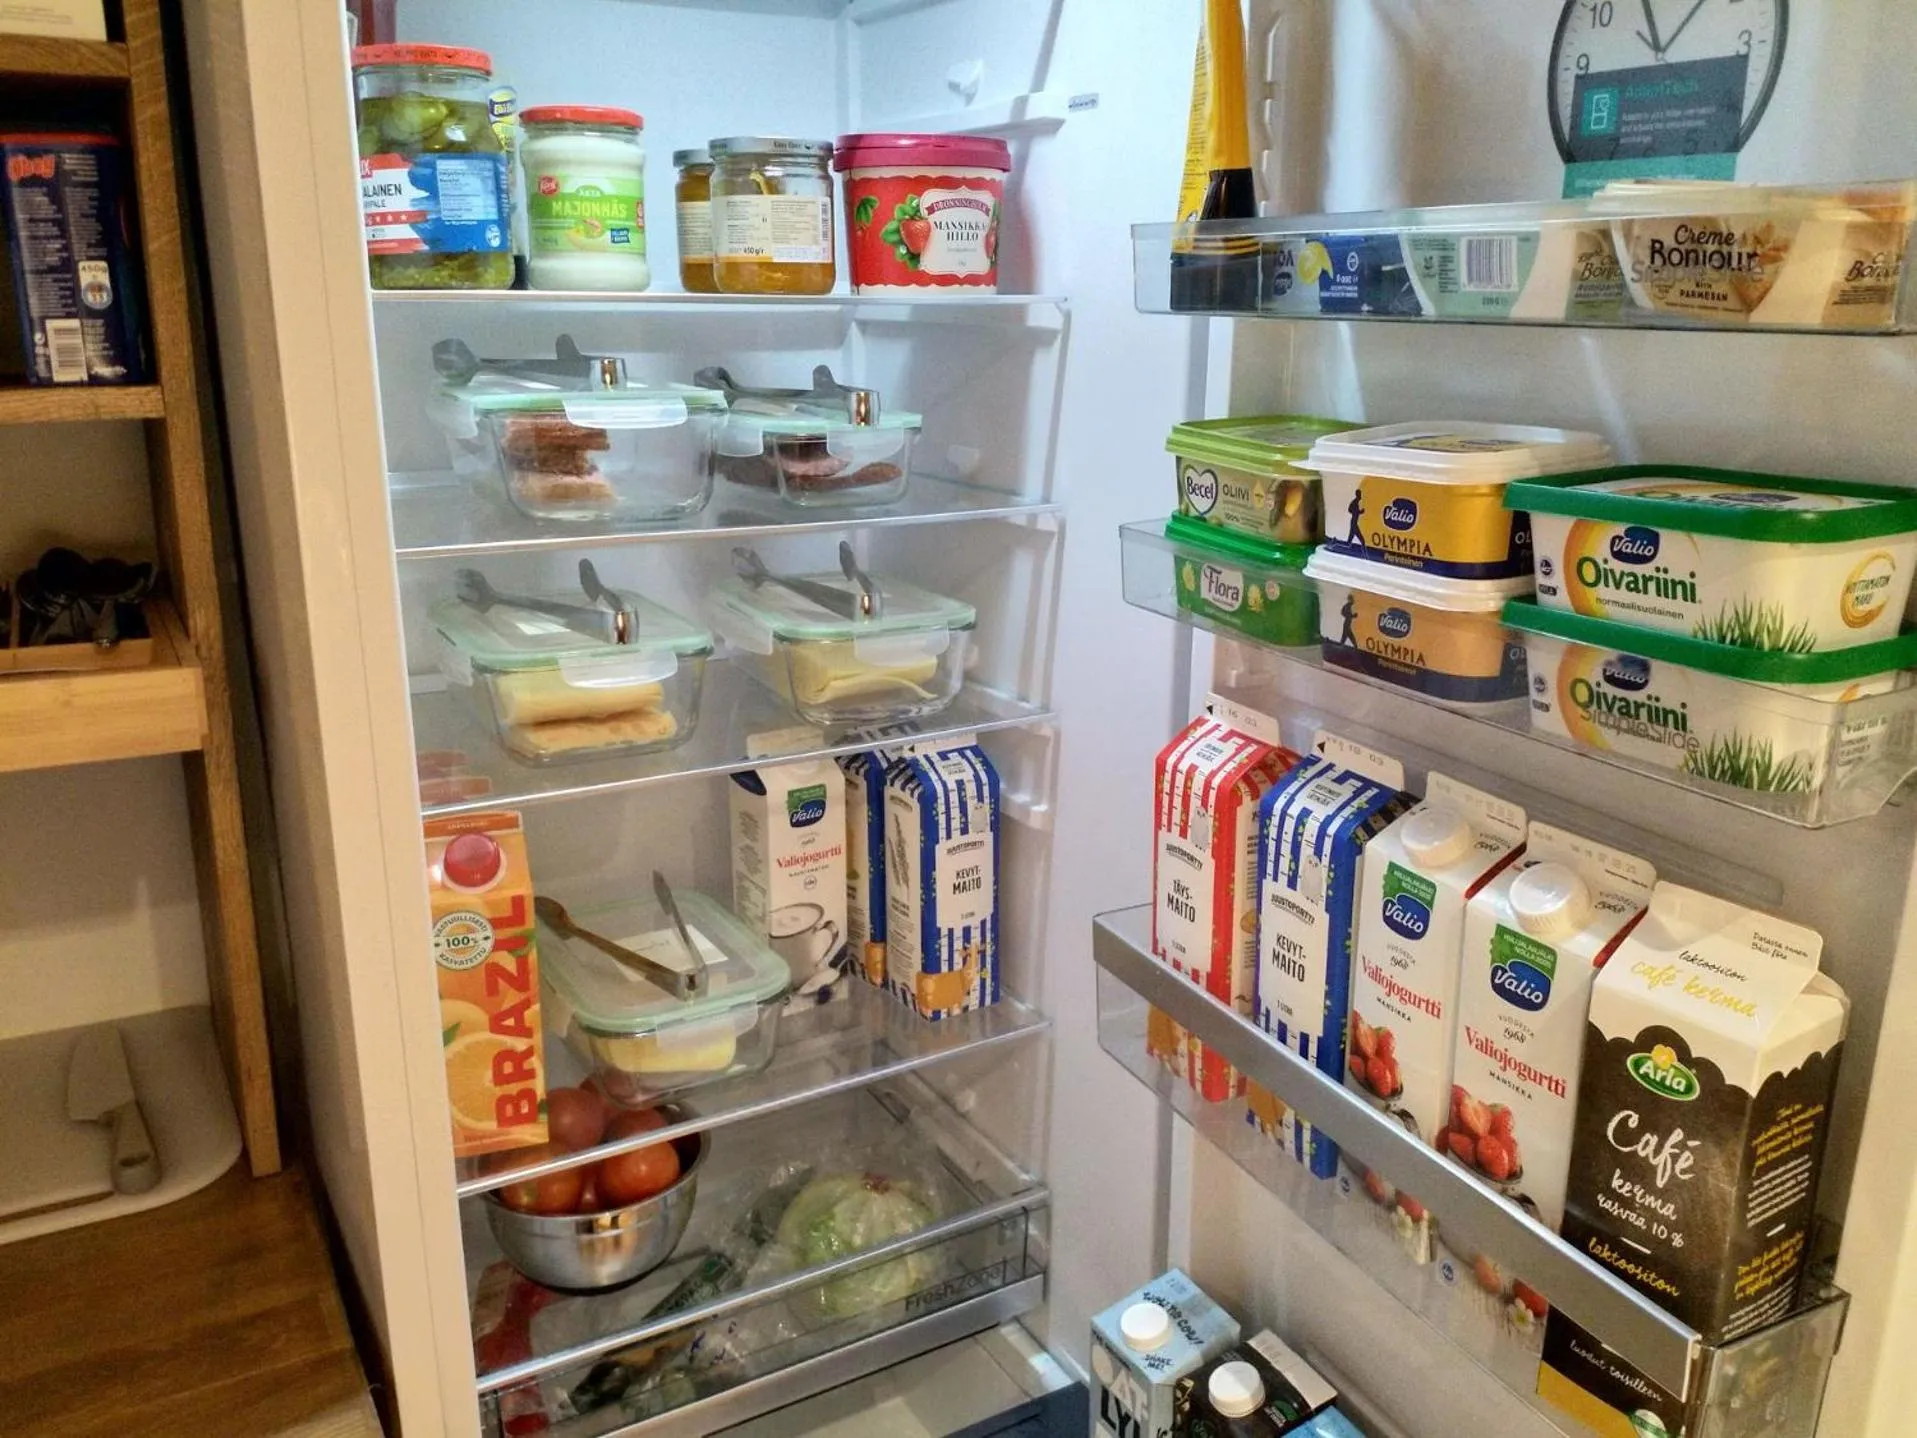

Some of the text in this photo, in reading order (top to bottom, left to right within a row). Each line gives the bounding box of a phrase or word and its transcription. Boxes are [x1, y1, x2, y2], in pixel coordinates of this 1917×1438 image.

[1589, 0, 1614, 29] 10
[1737, 29, 1753, 57] 3
[1576, 53, 1591, 76] 9
[551, 198, 628, 218] MAJONNÄS
[946, 232, 979, 242] HILLO
[1650, 237, 1760, 273] Bonjour
[1679, 288, 1729, 301] PARMESAN
[1186, 475, 1214, 500] Becel
[1384, 505, 1415, 524] Valio
[1371, 531, 1433, 557] OLYMPIA
[1612, 535, 1656, 557] Valio
[1203, 564, 1240, 601] Flora
[1576, 555, 1698, 604] Oivariini
[1379, 613, 1409, 633] Valio
[1595, 596, 1685, 621] normaalisuolainen
[1365, 636, 1427, 667] OLYMPIA
[1570, 677, 1690, 733] Oivariini
[791, 807, 823, 824] Valio
[776, 843, 843, 868] Valiojogurtti
[952, 875, 982, 896] MAITO
[1167, 890, 1196, 923] MAITO
[1384, 902, 1424, 933] Valio
[1275, 931, 1307, 960] KEVYT-
[1271, 946, 1306, 983] MAITO
[1361, 953, 1442, 1020] Valiojogurtti
[1493, 969, 1544, 1004] Valio
[484, 894, 540, 1130] BRAZIL
[1375, 995, 1412, 1023] MANSIKKA
[1464, 1024, 1567, 1100] Valiojogurtti
[1638, 1059, 1687, 1093] Arla
[1488, 1068, 1534, 1101] MANSIKKA
[1606, 1109, 1702, 1189] Café
[1610, 1167, 1678, 1222] kerma
[1596, 1192, 1685, 1249] rasvaa 10 %
[1588, 1236, 1681, 1298] laktoositon
